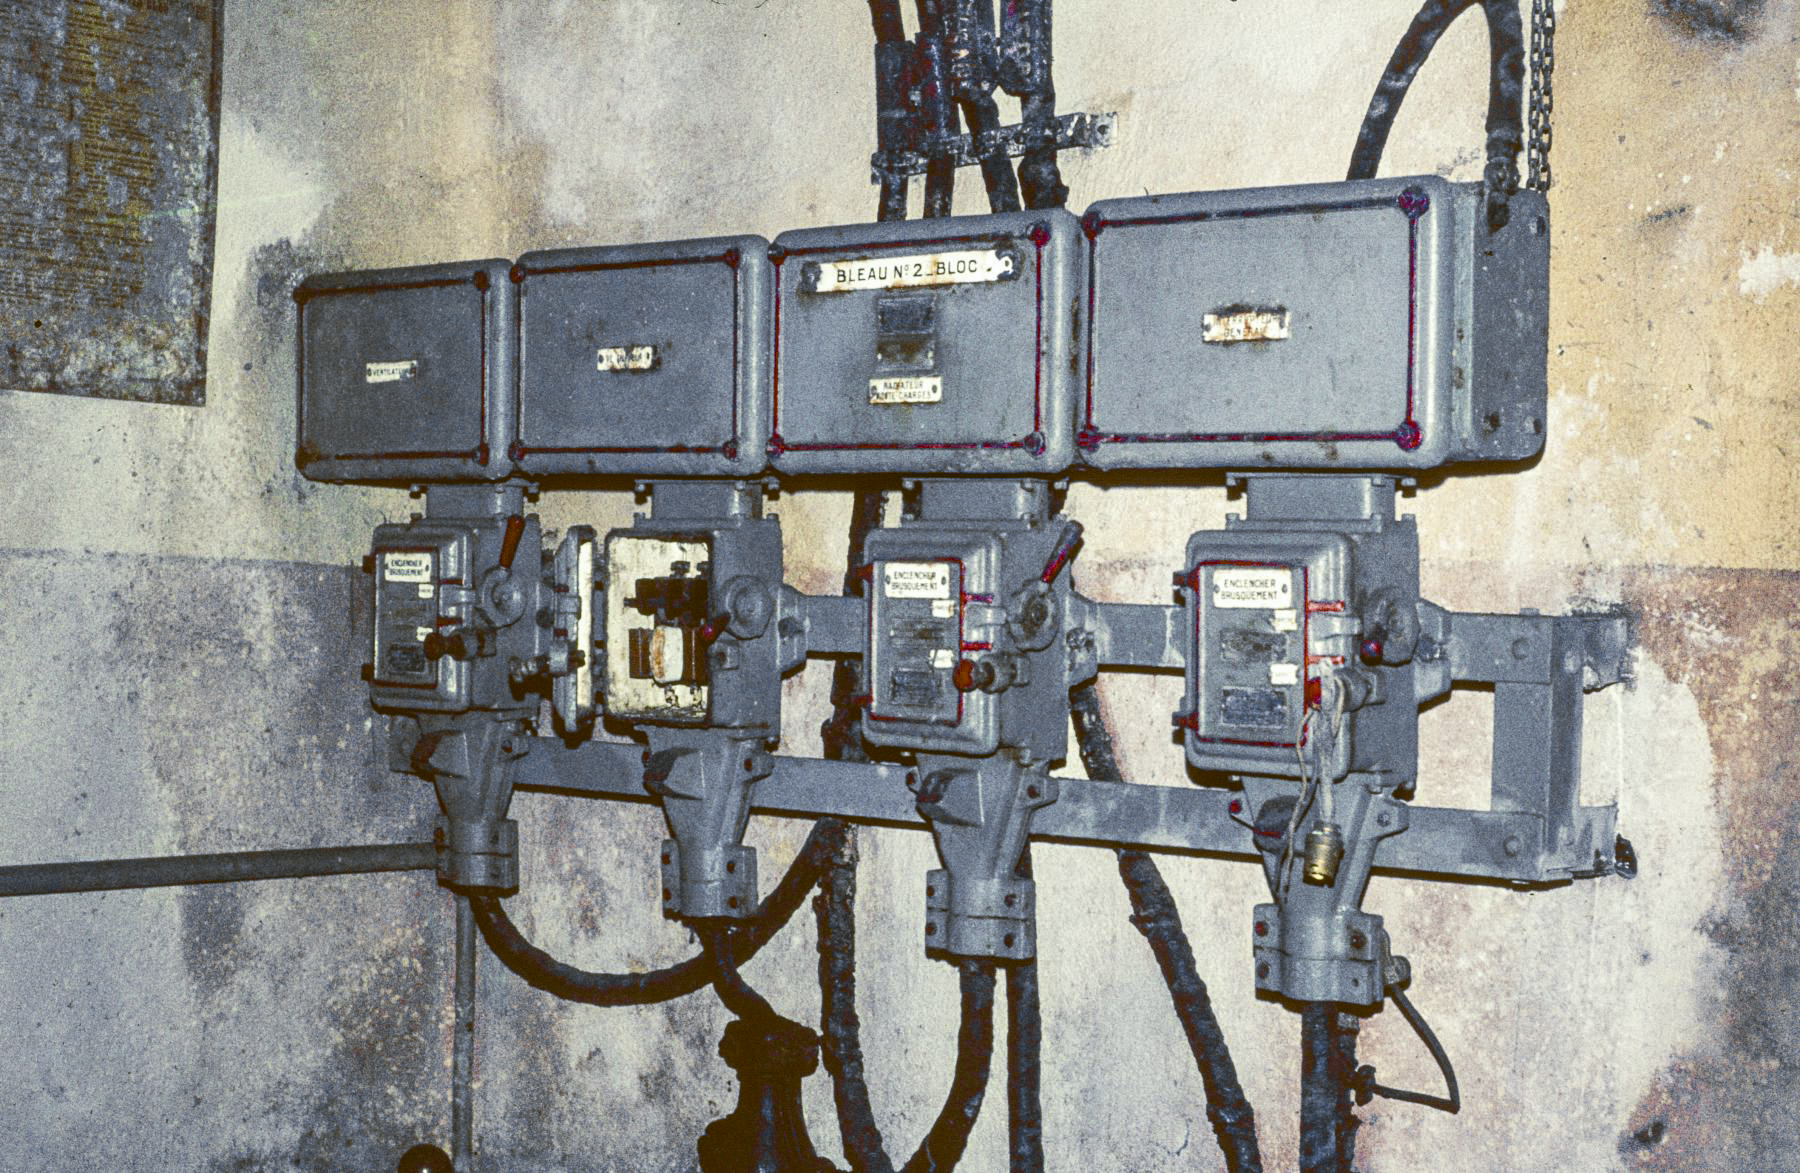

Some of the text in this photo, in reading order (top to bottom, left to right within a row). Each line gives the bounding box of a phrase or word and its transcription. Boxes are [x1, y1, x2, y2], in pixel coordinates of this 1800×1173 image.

[837, 265, 888, 283] BLEAU
[893, 571, 937, 580] ENCLENCHER
[891, 581, 938, 591] BRUSQUEMENT
[1223, 578, 1277, 589] ENCLENCHER
[1220, 590, 1278, 601] BRUSQUEMENT
